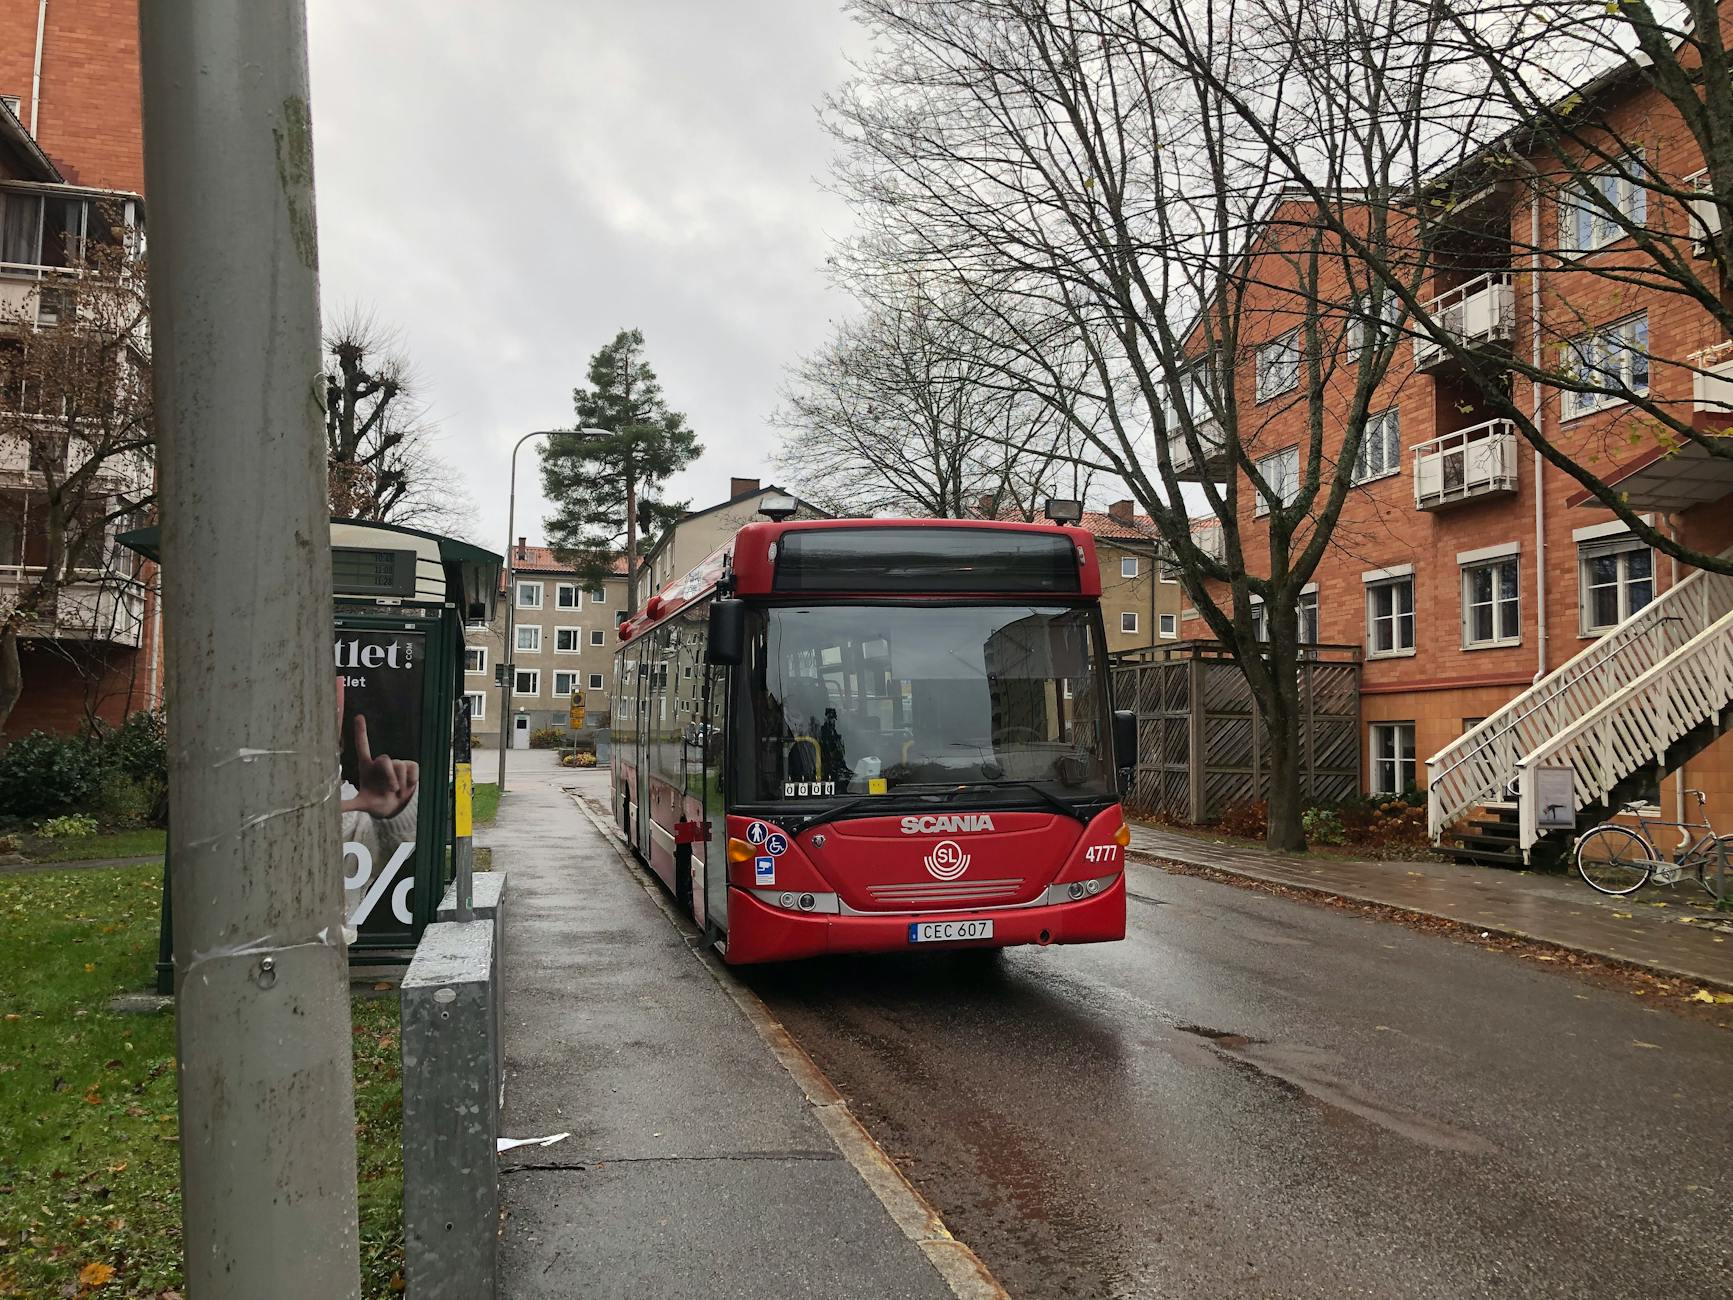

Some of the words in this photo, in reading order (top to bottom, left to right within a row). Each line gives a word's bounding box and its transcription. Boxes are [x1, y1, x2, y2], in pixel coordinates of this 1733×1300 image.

[900, 815, 995, 834] SCANIA
[937, 848, 957, 863] SL
[1085, 844, 1117, 863] 4777
[923, 924, 953, 939] CEC
[957, 922, 987, 937] 607
